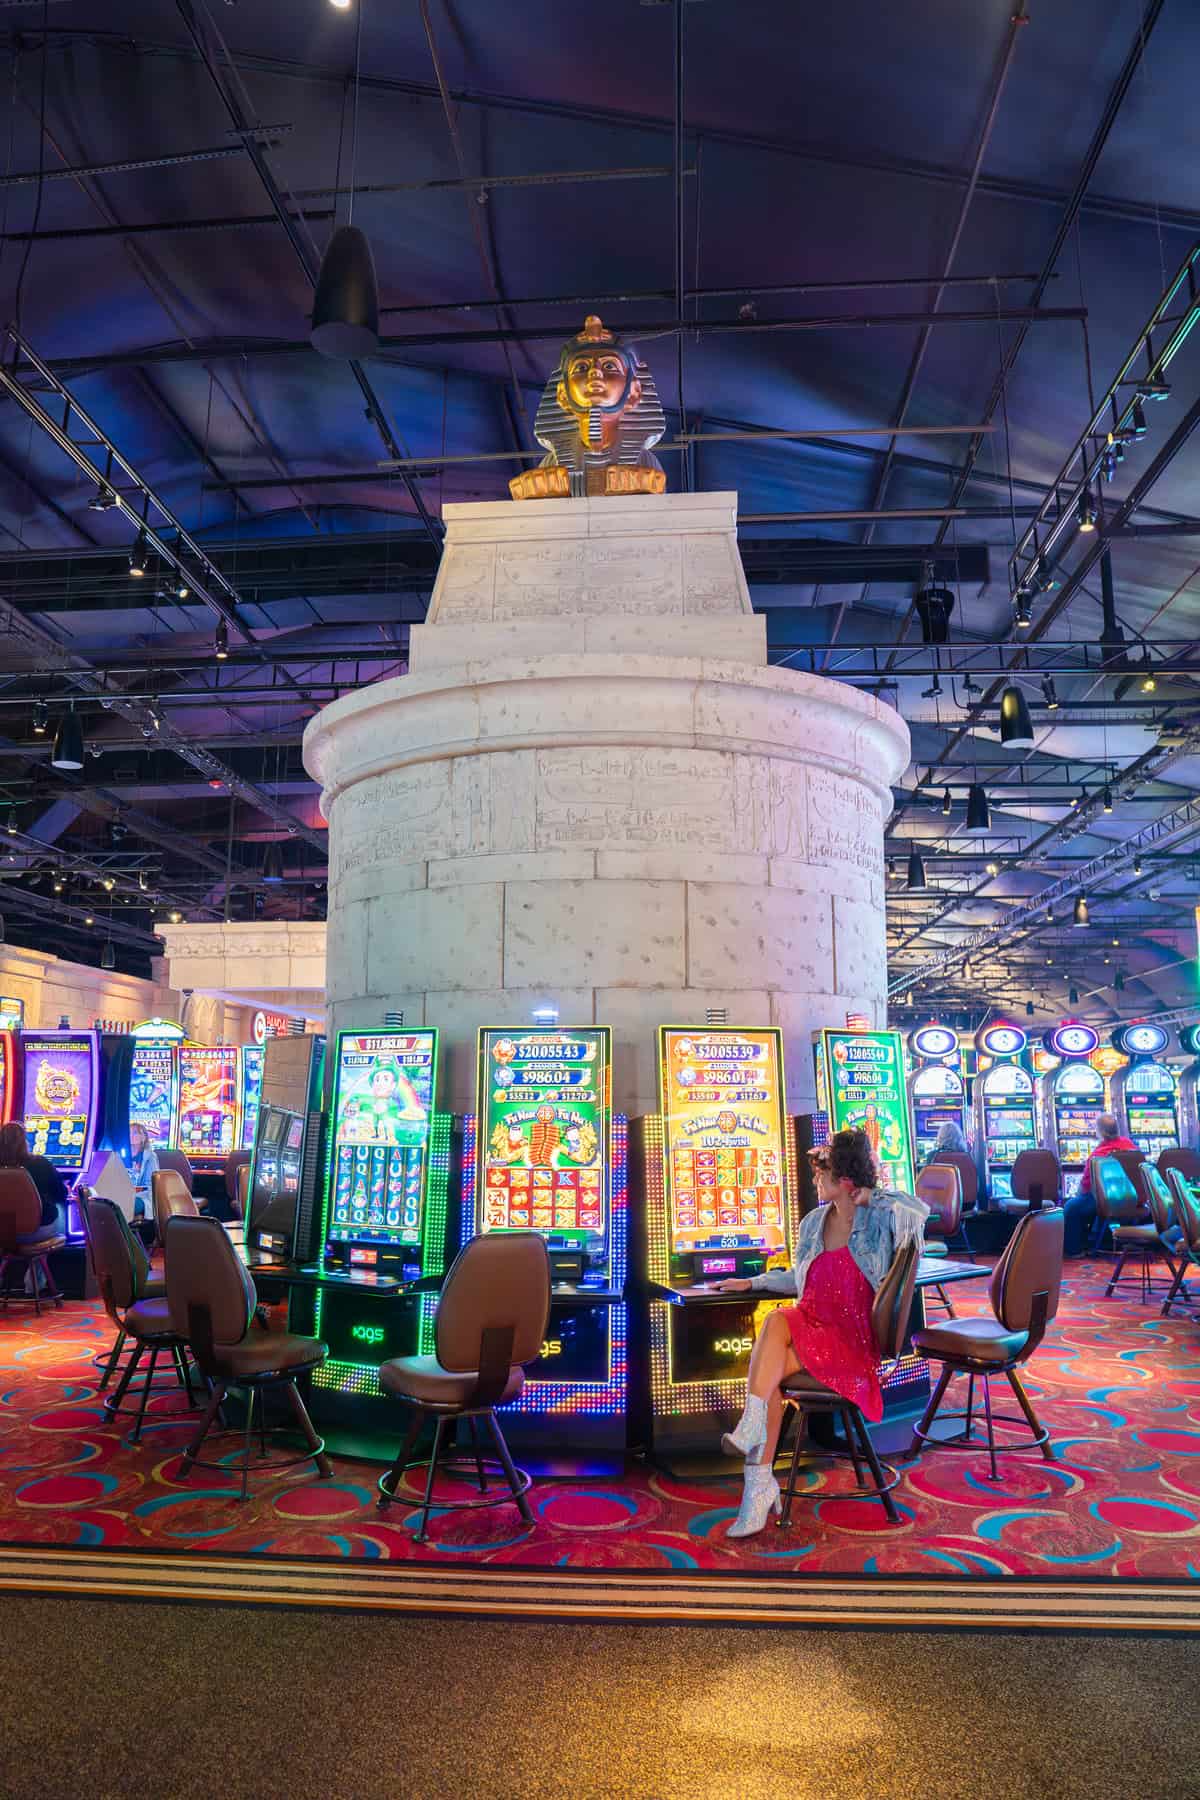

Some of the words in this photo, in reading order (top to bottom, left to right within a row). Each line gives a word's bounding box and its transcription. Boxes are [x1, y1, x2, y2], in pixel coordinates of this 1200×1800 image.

[522, 1070, 571, 1084] $986.04
[374, 1148, 385, 1160] Q
[356, 1163, 368, 1175] Q
[557, 1172, 574, 1186] K
[720, 1189, 737, 1206] Q
[337, 1209, 349, 1222] Q
[353, 1209, 366, 1222] Q
[539, 1340, 562, 1358] gs
